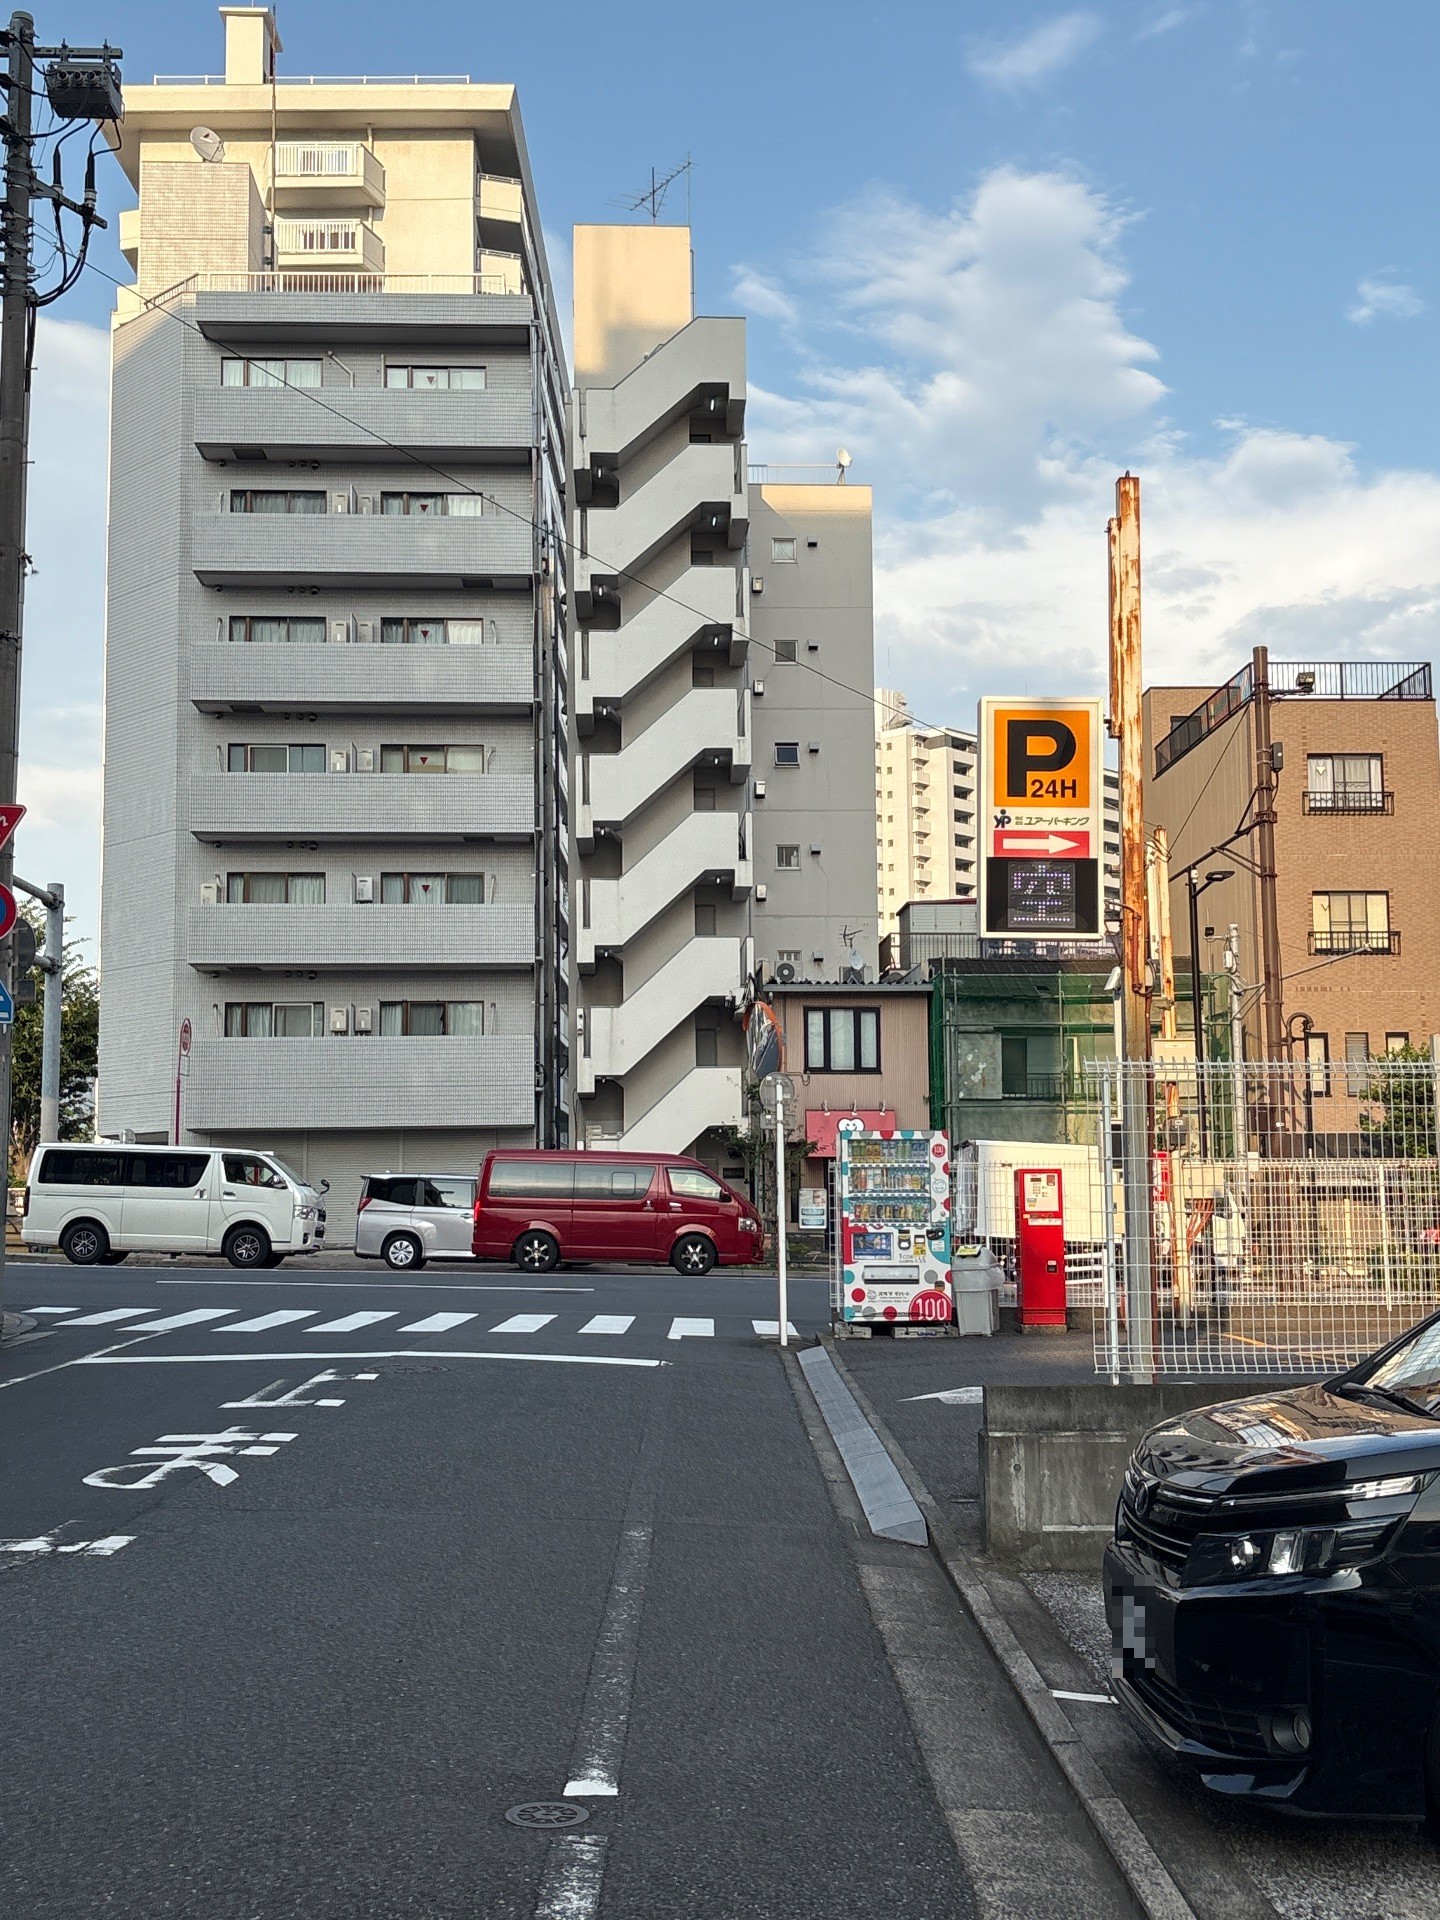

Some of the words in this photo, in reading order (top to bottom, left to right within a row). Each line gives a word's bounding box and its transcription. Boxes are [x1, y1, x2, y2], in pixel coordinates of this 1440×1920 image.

[1007, 720, 1076, 797] P
[1030, 779, 1077, 798] 24H
[1012, 864, 1072, 922] 空
[916, 1297, 948, 1321] 100
